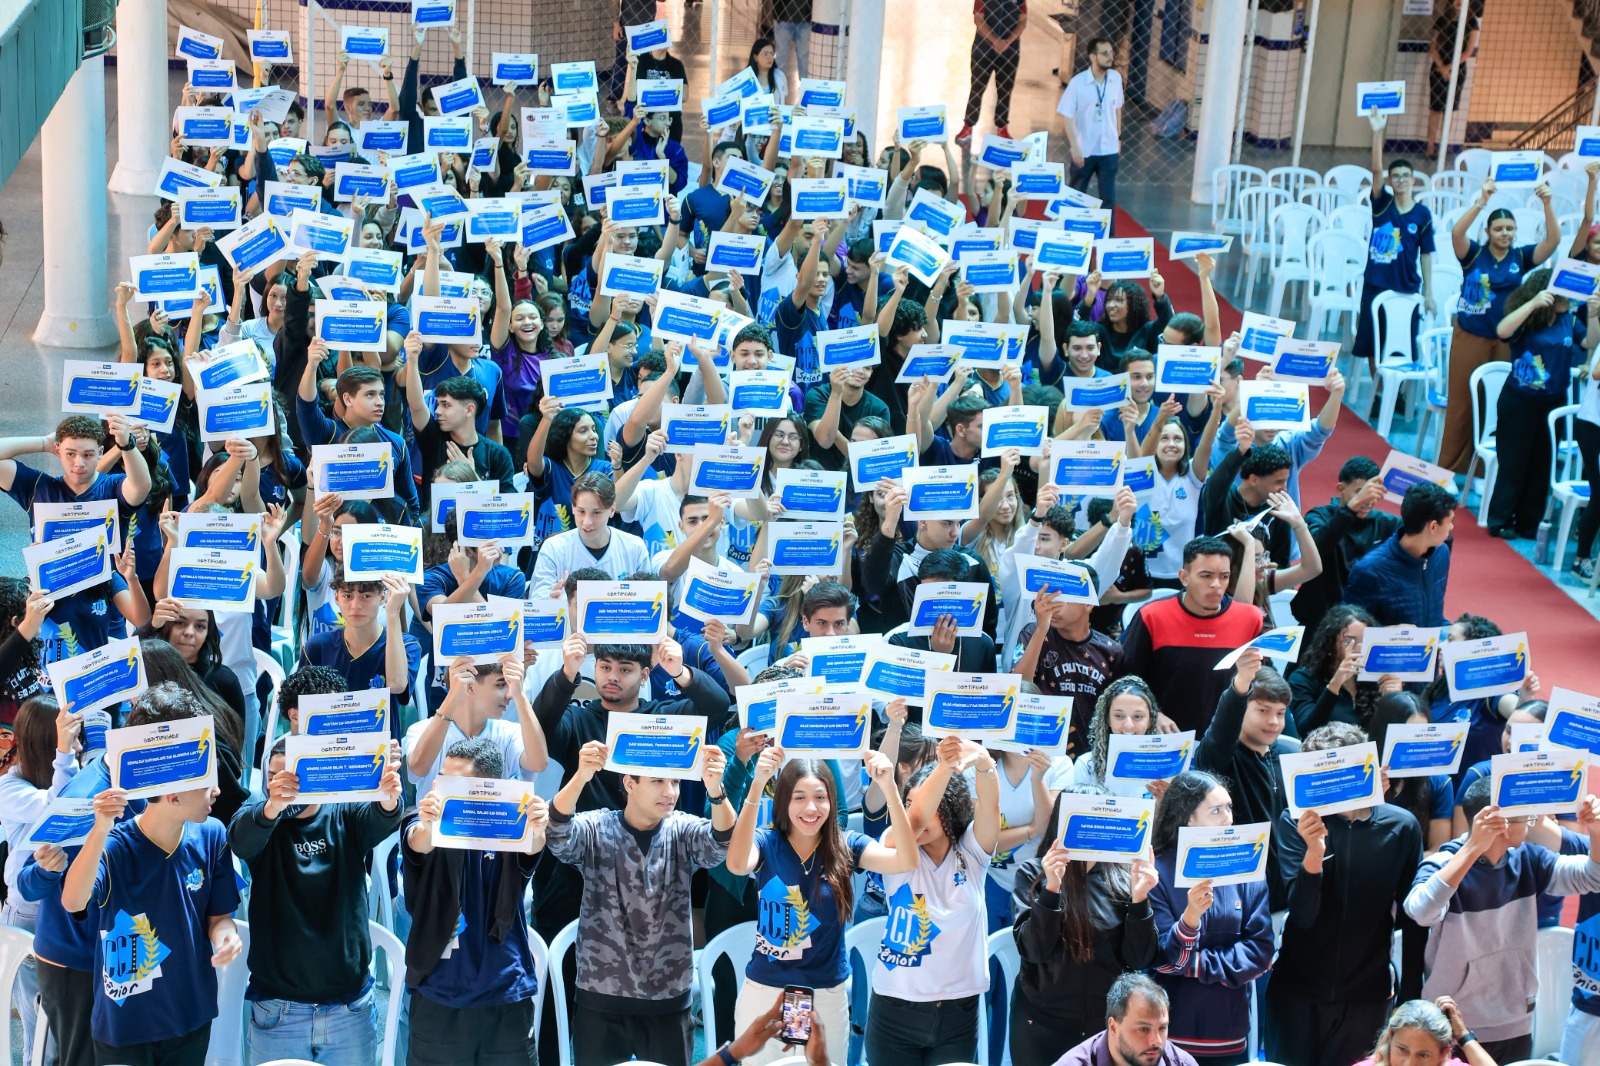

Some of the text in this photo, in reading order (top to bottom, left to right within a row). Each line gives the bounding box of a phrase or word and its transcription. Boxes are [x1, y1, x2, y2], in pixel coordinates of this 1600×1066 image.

[1062, 662, 1089, 674] AUTO
[1091, 668, 1106, 685] DE
[1060, 679, 1076, 692] SÃO
[294, 839, 326, 853] BOSS
[757, 898, 794, 941] CCI
[106, 934, 140, 978] CCI
